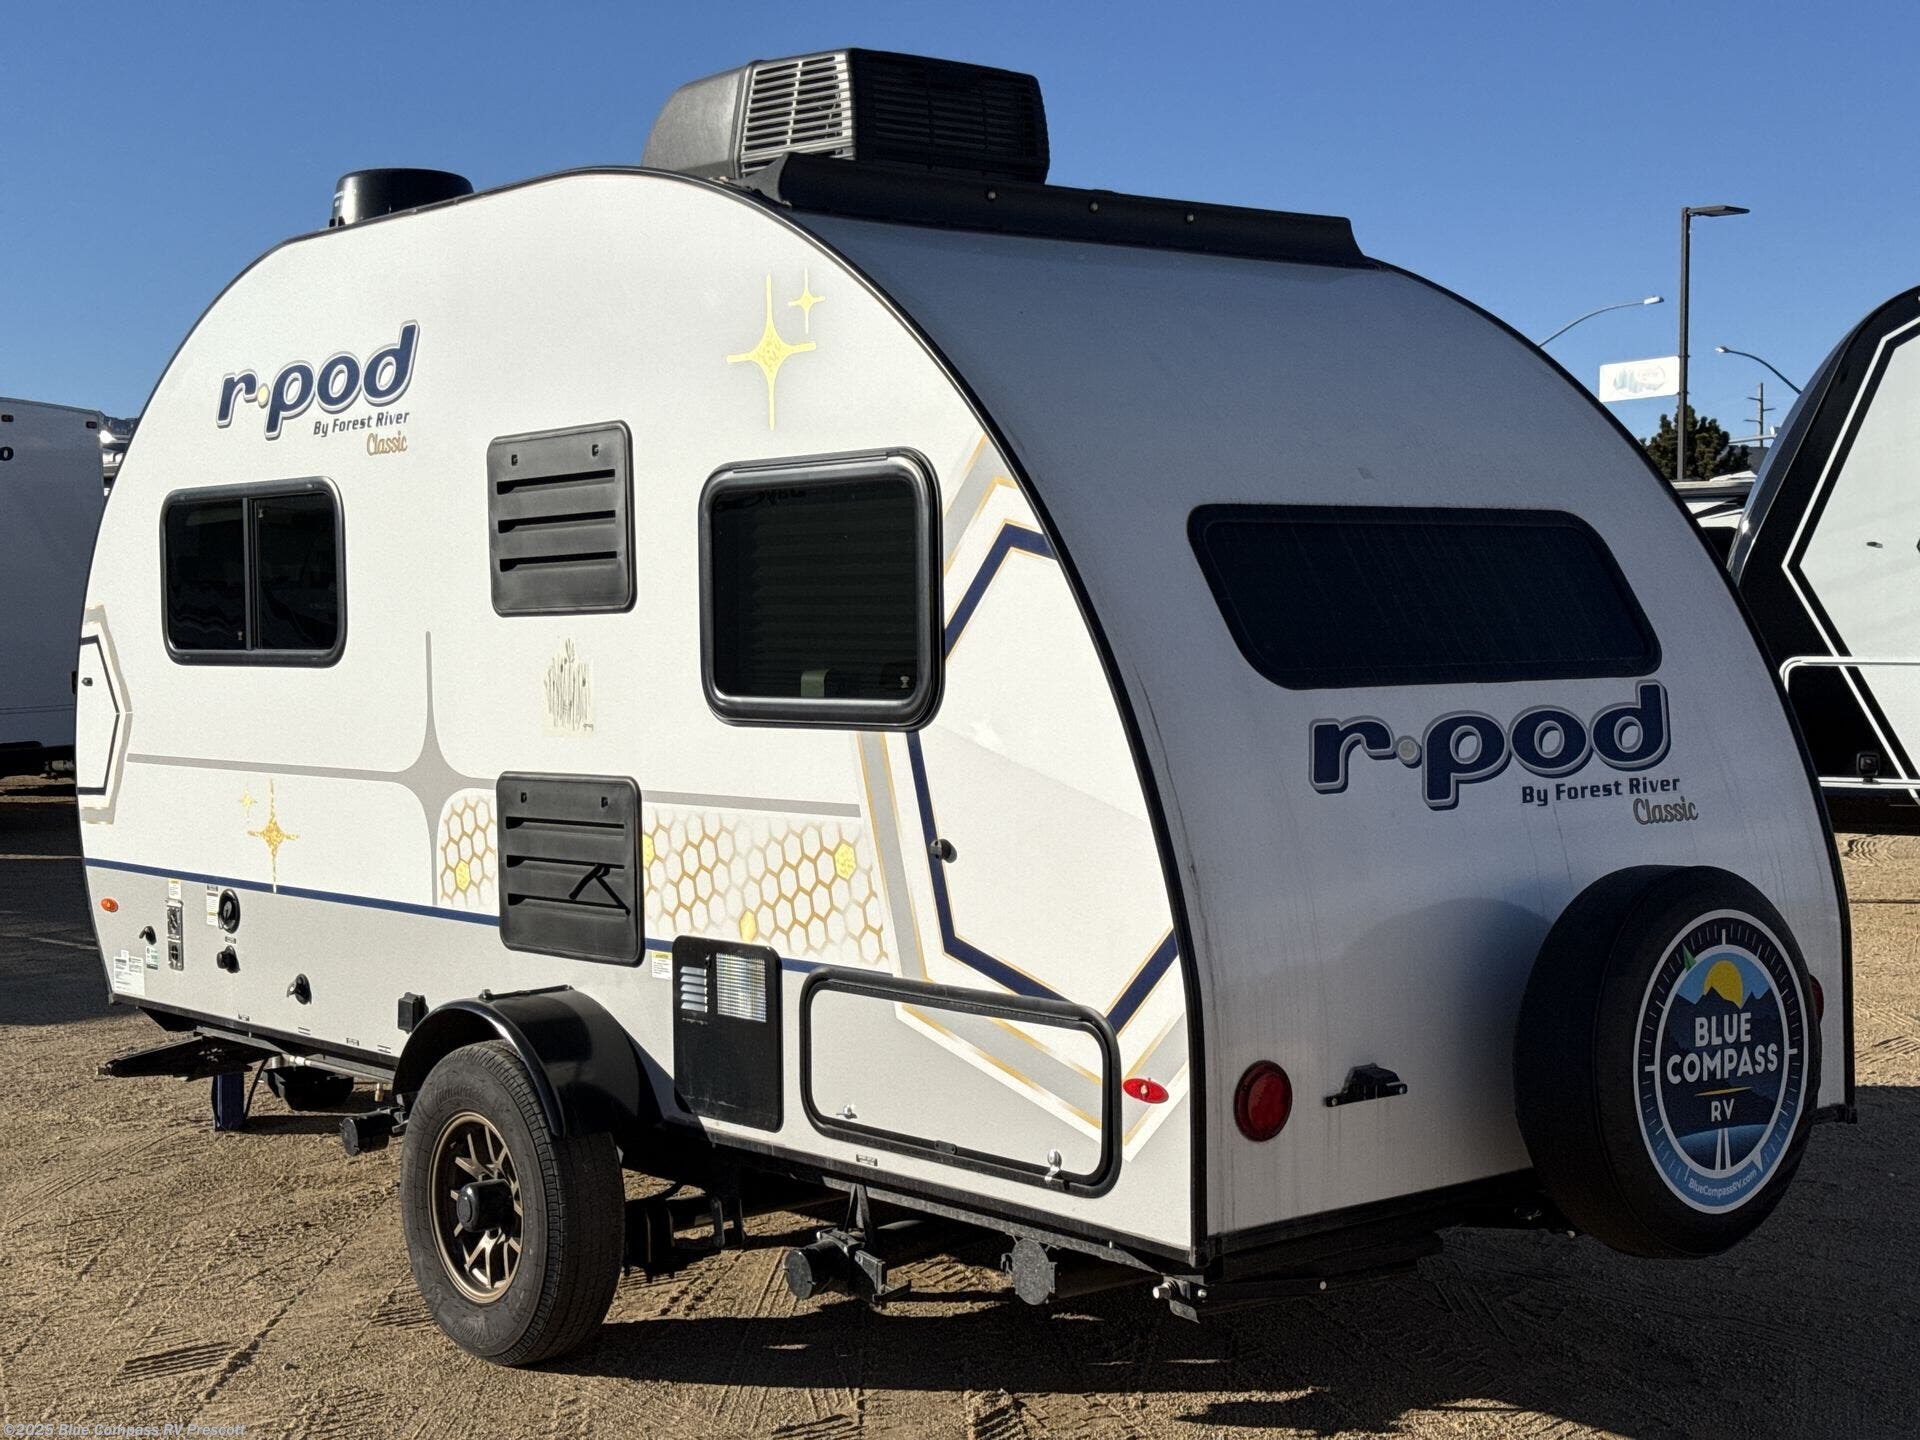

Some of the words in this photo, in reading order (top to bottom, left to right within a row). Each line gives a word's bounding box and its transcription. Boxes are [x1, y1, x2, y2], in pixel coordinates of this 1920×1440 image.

[313, 420, 329, 438] By
[332, 415, 373, 434] Forest
[375, 411, 410, 428] River
[366, 430, 408, 456] Classic
[1521, 785, 1549, 807] By
[1555, 780, 1623, 801] Forest
[1628, 776, 1681, 795] River
[1632, 795, 1699, 826] Classic
[1694, 1012, 1752, 1048] BLUE
[1666, 1042, 1779, 1085] COMPASS
[1710, 1098, 1736, 1122] RV
[1688, 1168, 1759, 1199] BlueCompassRV.com
